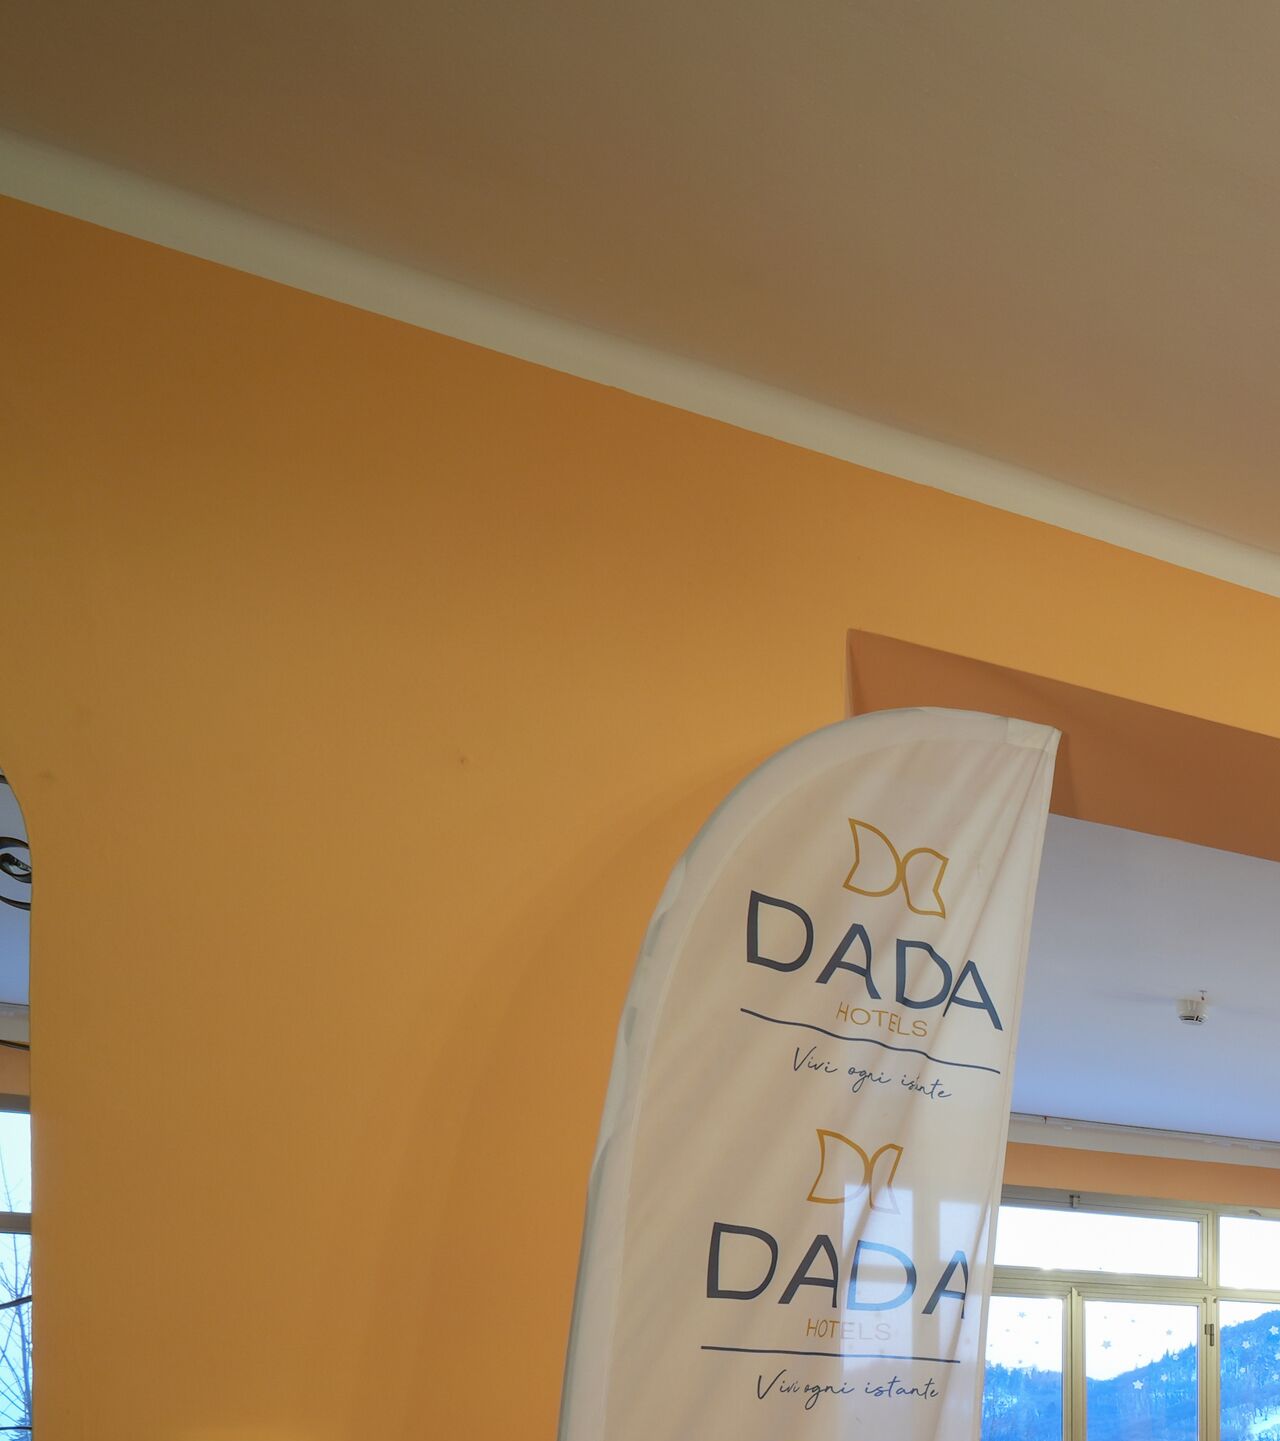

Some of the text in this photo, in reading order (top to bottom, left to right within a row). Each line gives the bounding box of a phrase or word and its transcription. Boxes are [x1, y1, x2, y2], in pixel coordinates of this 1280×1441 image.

[746, 889, 1004, 1031] DADA
[835, 1001, 928, 1038] HOTELS
[792, 1045, 838, 1074] Vivi
[847, 1066, 891, 1093] ogni
[706, 1221, 969, 1320] DADA
[806, 1318, 892, 1342] HOTELS
[756, 1368, 940, 1411] Vivi ogni istante
